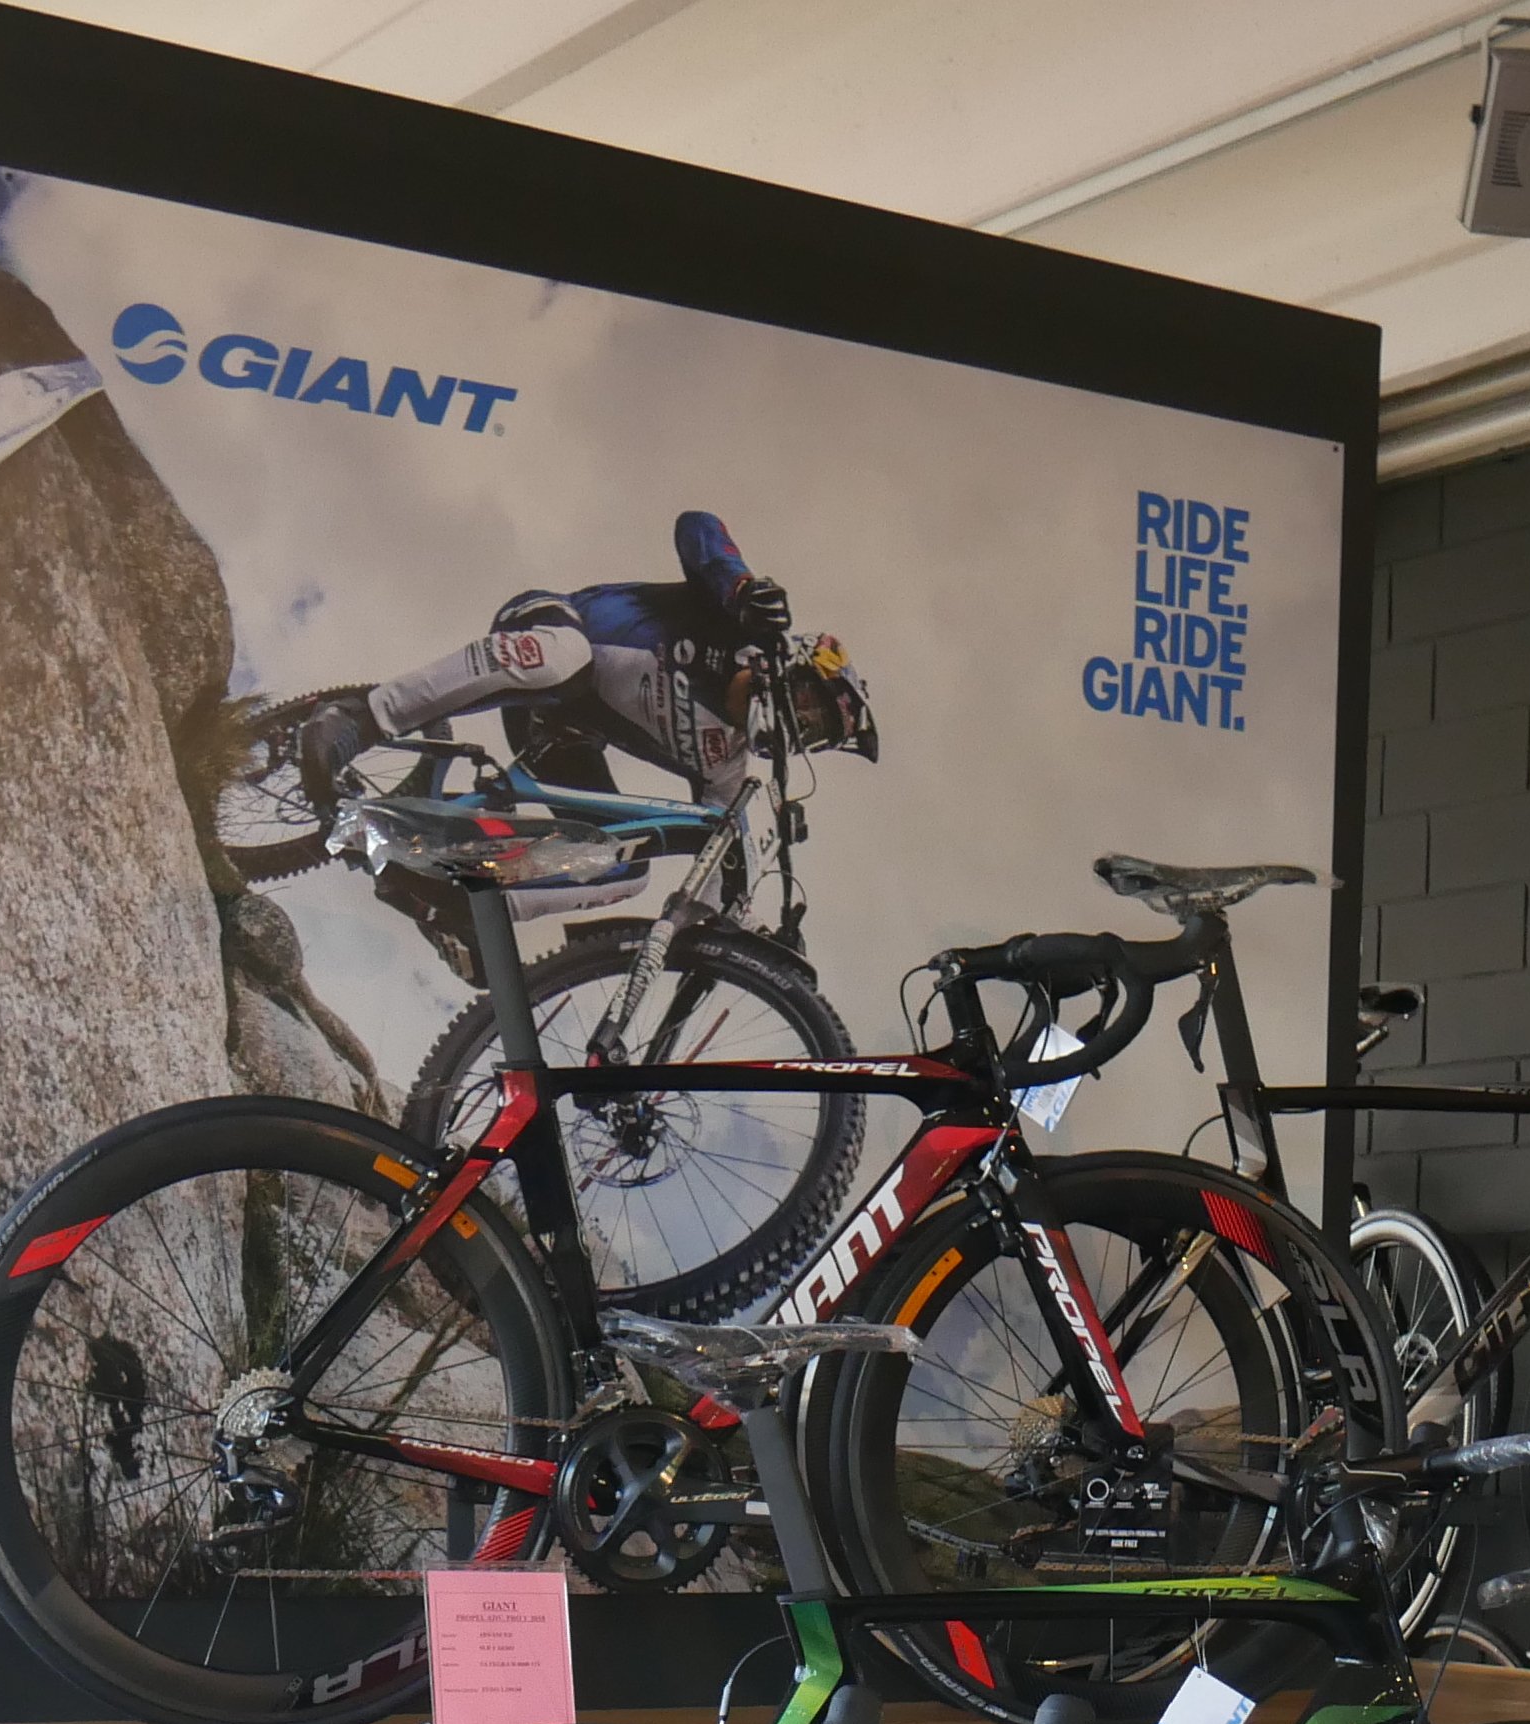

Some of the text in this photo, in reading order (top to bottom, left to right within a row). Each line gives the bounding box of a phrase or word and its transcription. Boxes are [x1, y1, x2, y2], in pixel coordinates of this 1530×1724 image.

[198, 334, 517, 434] GIANT
[1137, 490, 1249, 562] RIDE
[1135, 550, 1248, 619] LIFE.
[1134, 611, 1247, 674] RIDE
[673, 670, 695, 768] GIANT
[1082, 656, 1246, 731] GIANT.
[773, 1059, 921, 1077] PROPEL
[767, 1161, 907, 1325] IANT
[1020, 1222, 1121, 1425] PROPEL
[399, 1436, 535, 1467] ADVANCED
[482, 1600, 518, 1611] GIANT
[1140, 1584, 1298, 1600] PROPEL
[312, 1633, 427, 1704] LR
